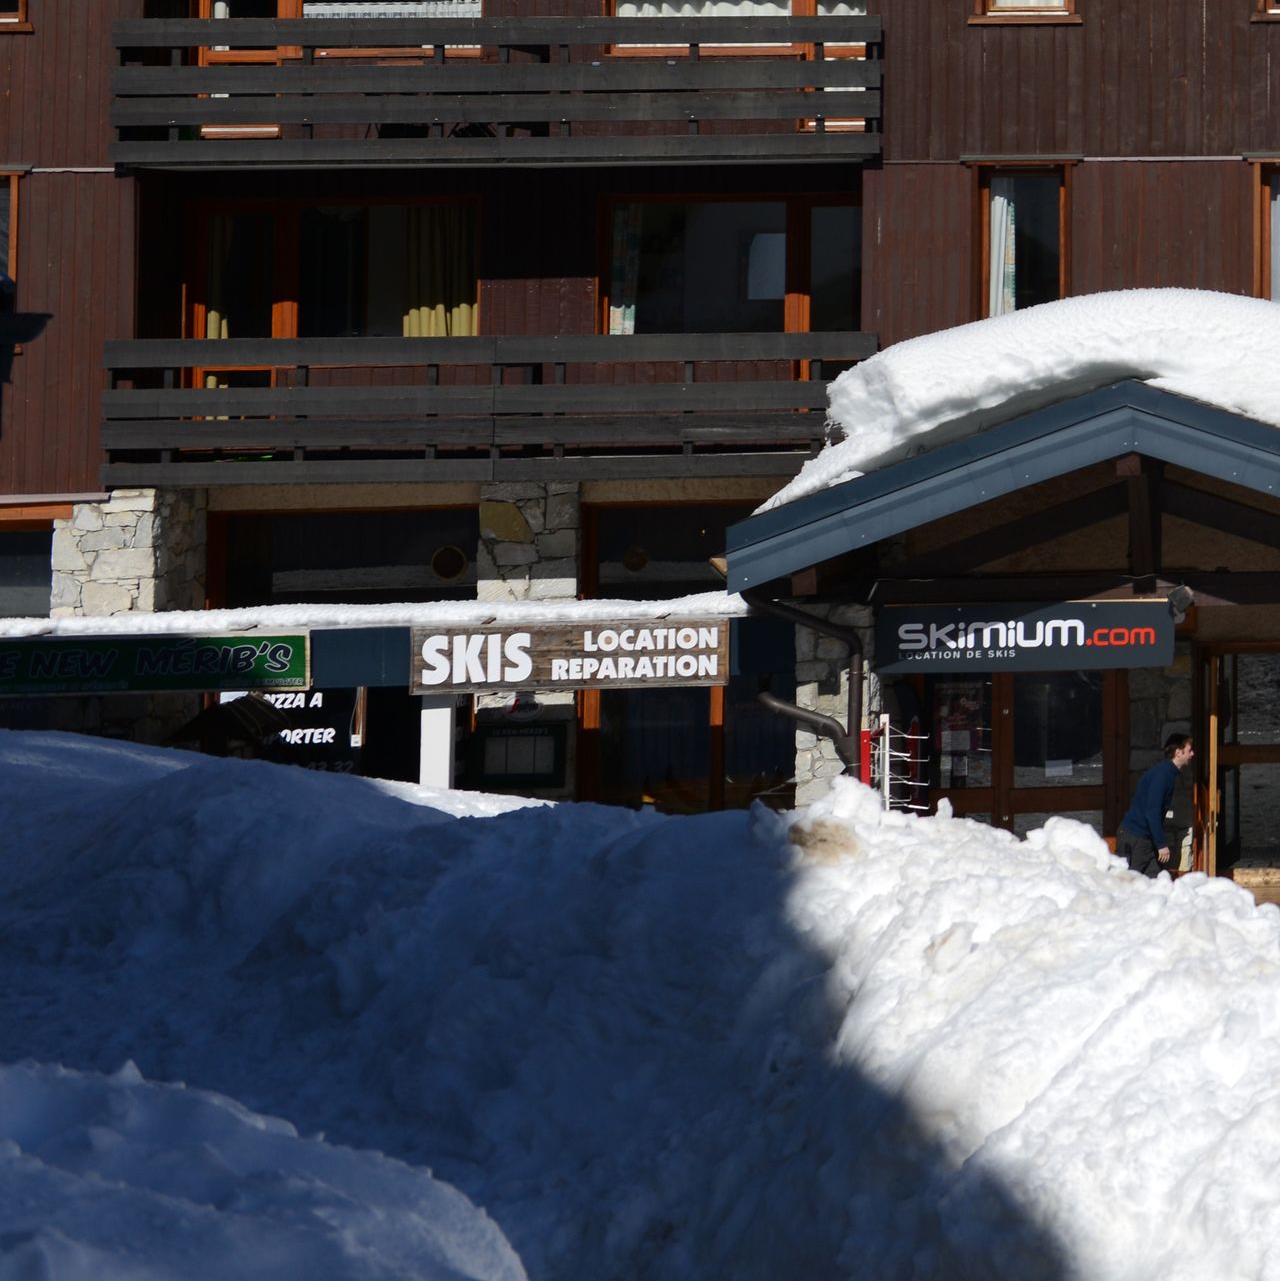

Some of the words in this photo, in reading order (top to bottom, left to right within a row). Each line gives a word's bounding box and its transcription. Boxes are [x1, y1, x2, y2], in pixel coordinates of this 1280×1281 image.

[583, 627, 719, 652] LOCATION
[0, 650, 22, 681] E
[28, 647, 120, 680] NEW
[134, 638, 294, 676] MÉRIB'S
[421, 631, 533, 686] SKIS
[551, 654, 718, 681] REPARATION
[898, 649, 961, 661] LOCATION
[966, 649, 982, 660] DE
[987, 648, 1016, 659] SKIS
[309, 692, 324, 708] A
